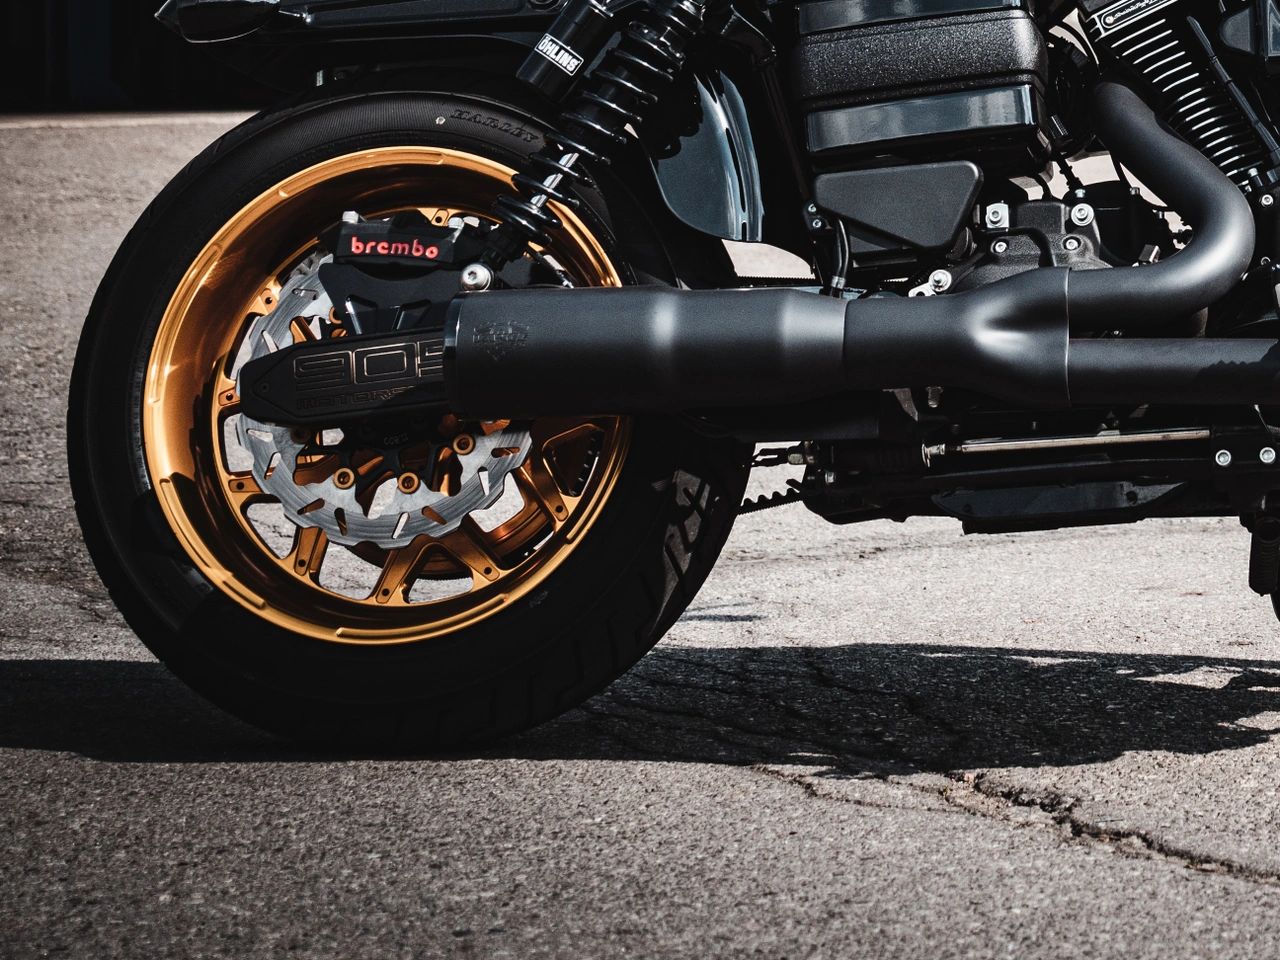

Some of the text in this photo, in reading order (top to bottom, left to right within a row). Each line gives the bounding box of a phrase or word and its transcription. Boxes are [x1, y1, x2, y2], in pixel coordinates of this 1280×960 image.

[538, 35, 580, 72] ÖHLINS
[450, 108, 539, 143] HARLEY
[351, 236, 440, 260] brembo
